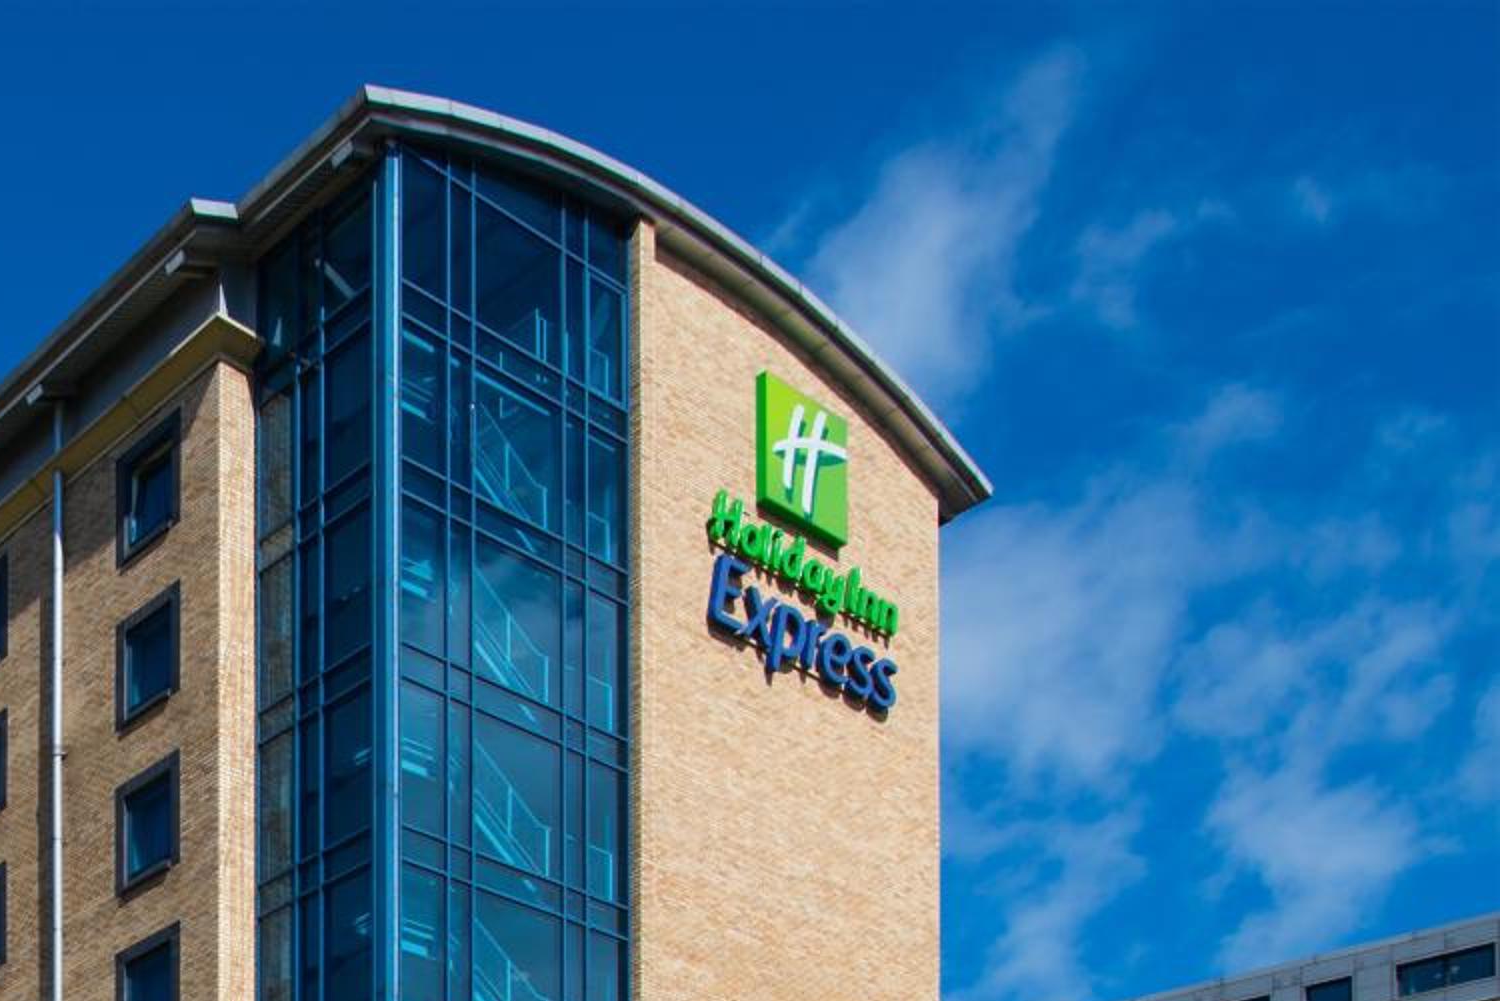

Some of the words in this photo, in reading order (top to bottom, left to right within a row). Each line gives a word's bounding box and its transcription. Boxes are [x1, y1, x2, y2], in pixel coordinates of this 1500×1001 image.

[772, 404, 847, 512] H
[707, 488, 845, 615] Holiday
[845, 565, 899, 637] Inn
[707, 553, 898, 709] Express
